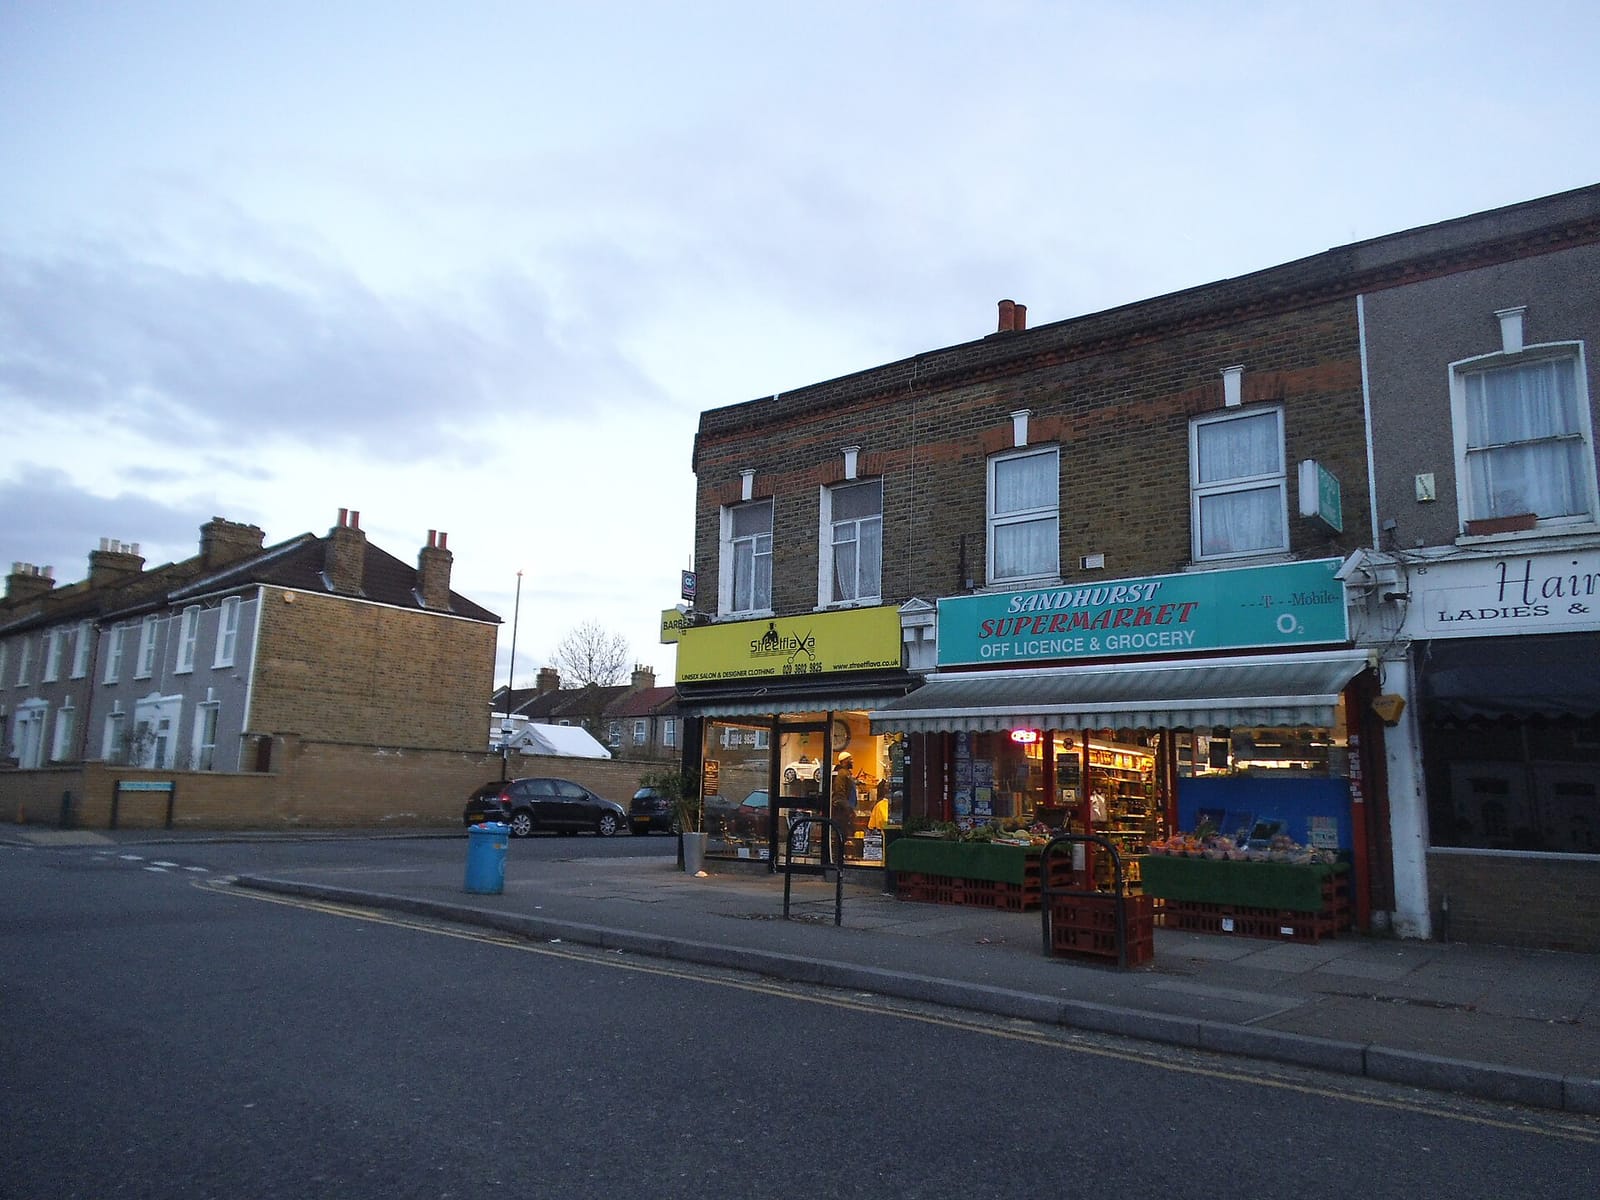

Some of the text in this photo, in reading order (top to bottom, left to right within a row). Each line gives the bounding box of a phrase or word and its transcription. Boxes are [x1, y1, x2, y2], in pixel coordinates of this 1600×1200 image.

[1417, 567, 1427, 576] 8
[1496, 559, 1600, 606] Hair
[1007, 581, 1162, 614] SANDHURST
[978, 601, 1199, 639] SUPERMARKET
[1438, 602, 1590, 622] LADIES &
[663, 618, 688, 630] BARBE
[980, 630, 1196, 658] OFF LICENCE & GROCERY
[681, 673, 698, 681] UNISEX
[723, 670, 747, 678] DESIGNER
[748, 668, 775, 676] CLOTHING
[832, 659, 899, 670] www.streetflava.co.uk
